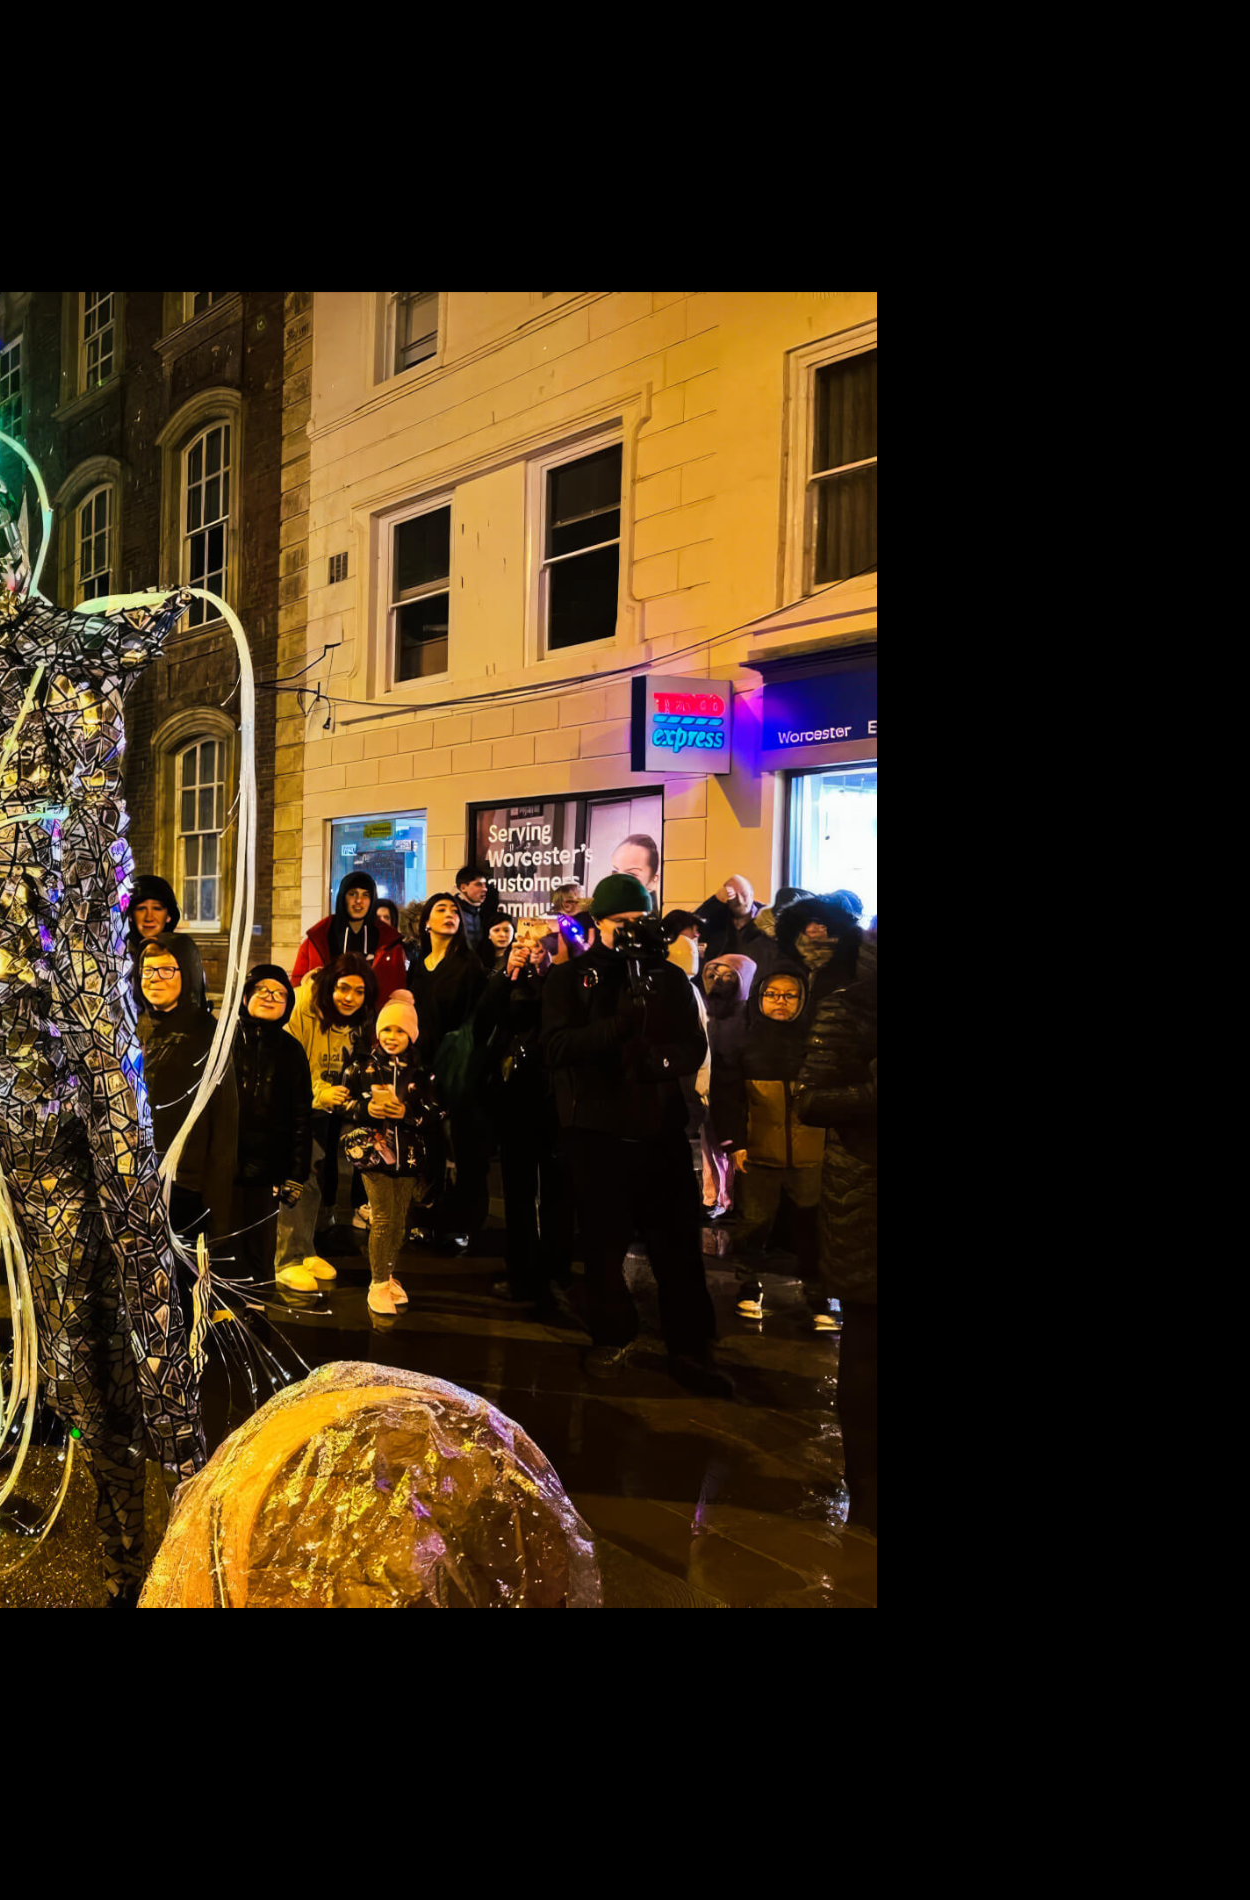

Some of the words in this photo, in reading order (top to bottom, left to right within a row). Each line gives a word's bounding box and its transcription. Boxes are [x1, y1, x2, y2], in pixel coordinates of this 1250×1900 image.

[652, 727, 725, 753] express
[778, 726, 852, 744] Worcester
[488, 822, 552, 845] Serving
[488, 843, 593, 868] Worcester's
